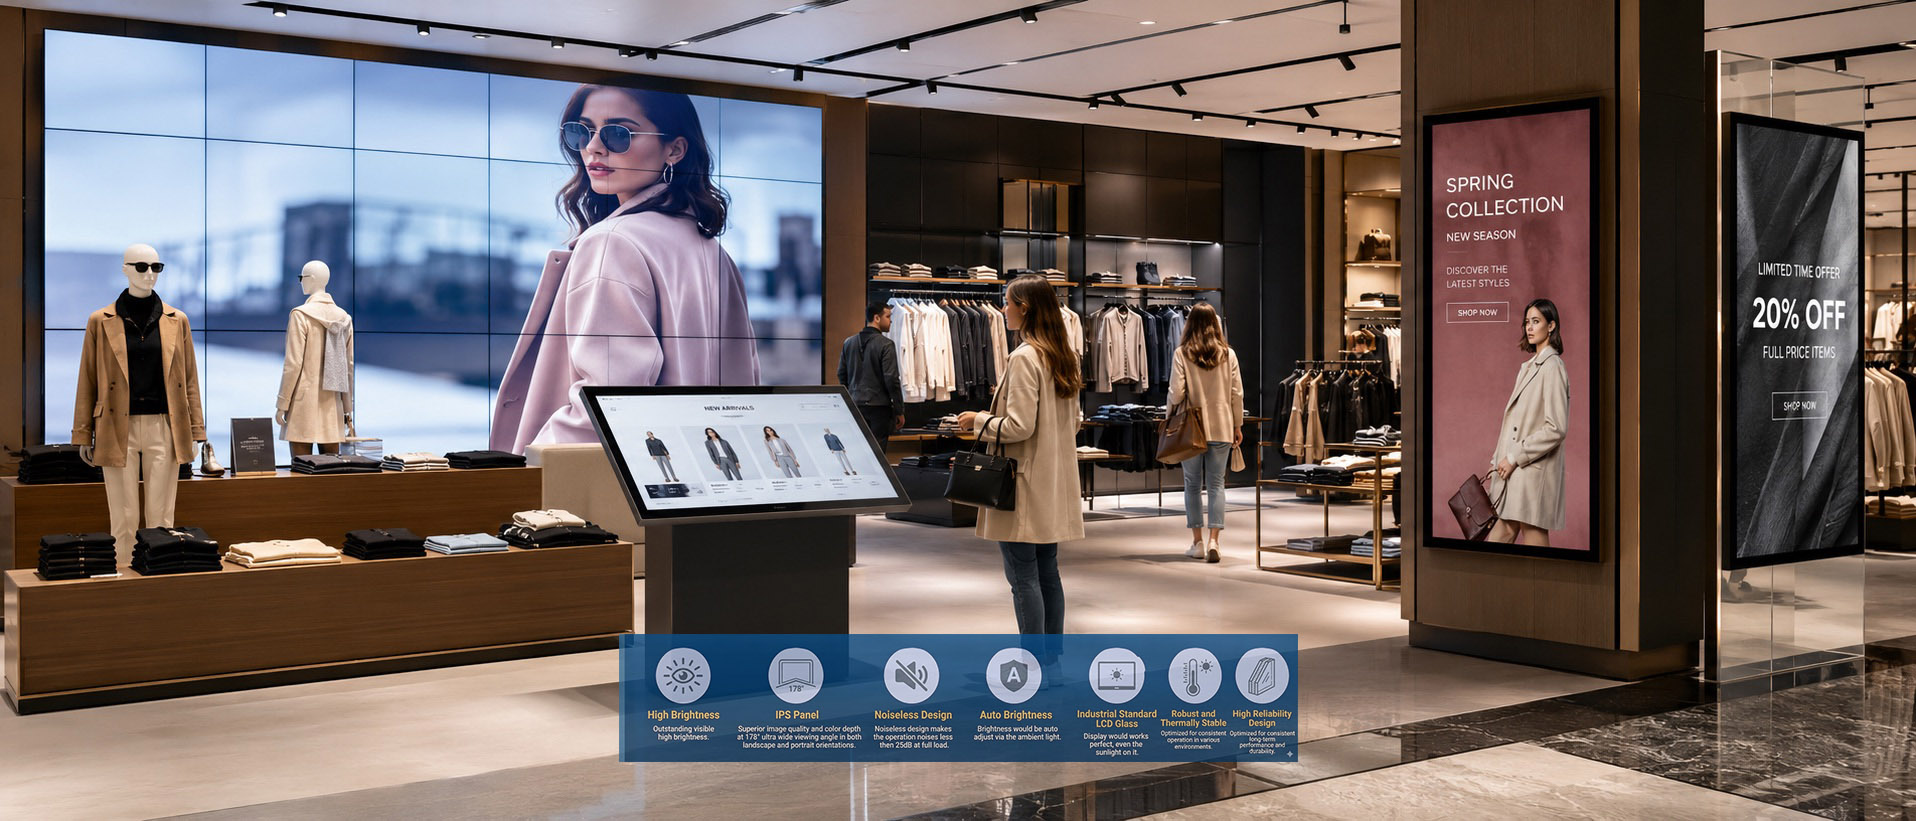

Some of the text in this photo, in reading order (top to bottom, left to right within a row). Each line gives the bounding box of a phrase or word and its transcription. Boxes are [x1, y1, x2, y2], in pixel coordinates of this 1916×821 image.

[1446, 173, 1514, 193] SPRING
[1446, 196, 1564, 218] COLLECTION
[1446, 230, 1516, 242] NEW SEASON
[1447, 264, 1508, 275] DISCOVER THE
[1758, 262, 1840, 279] LIMITED TIME OFFER
[1447, 278, 1510, 288] LATEST STYLES
[1753, 297, 1846, 329] 20% OFF
[1763, 346, 1836, 358] FULL PRICE ITEMS
[1784, 401, 1816, 411] SHOP NOW
